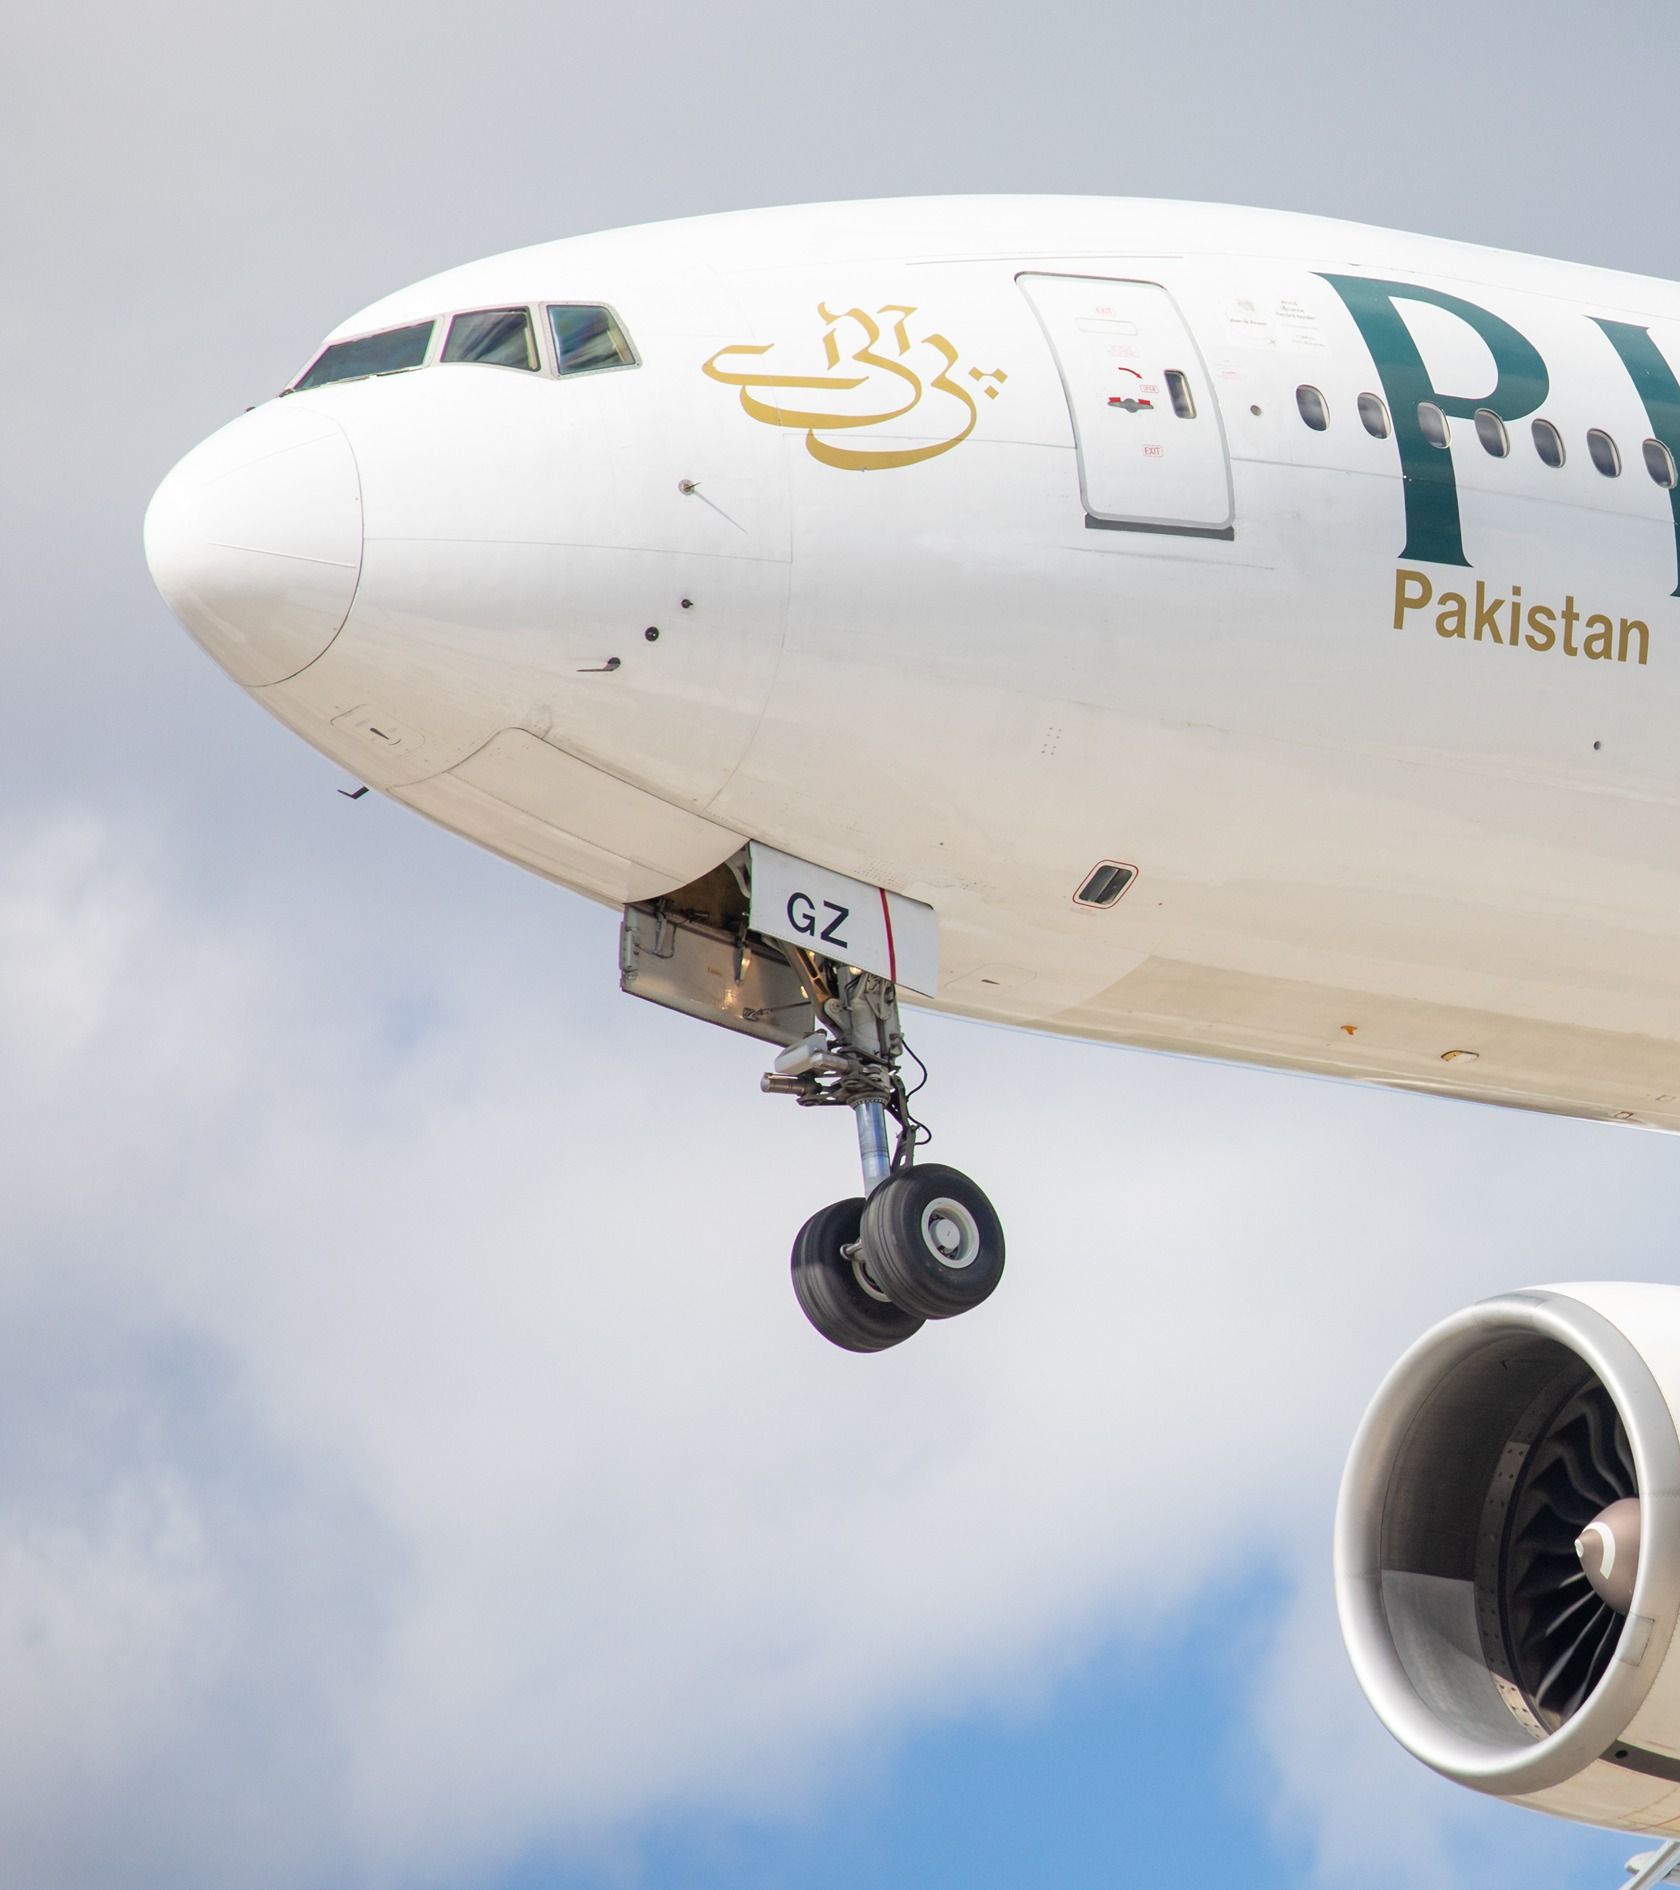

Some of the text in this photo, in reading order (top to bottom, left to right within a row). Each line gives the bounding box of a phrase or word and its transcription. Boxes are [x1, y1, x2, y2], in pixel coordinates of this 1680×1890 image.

[1144, 446, 1161, 456] EXIT
[1392, 569, 1650, 665] Pakistan
[787, 892, 849, 949] GZ
